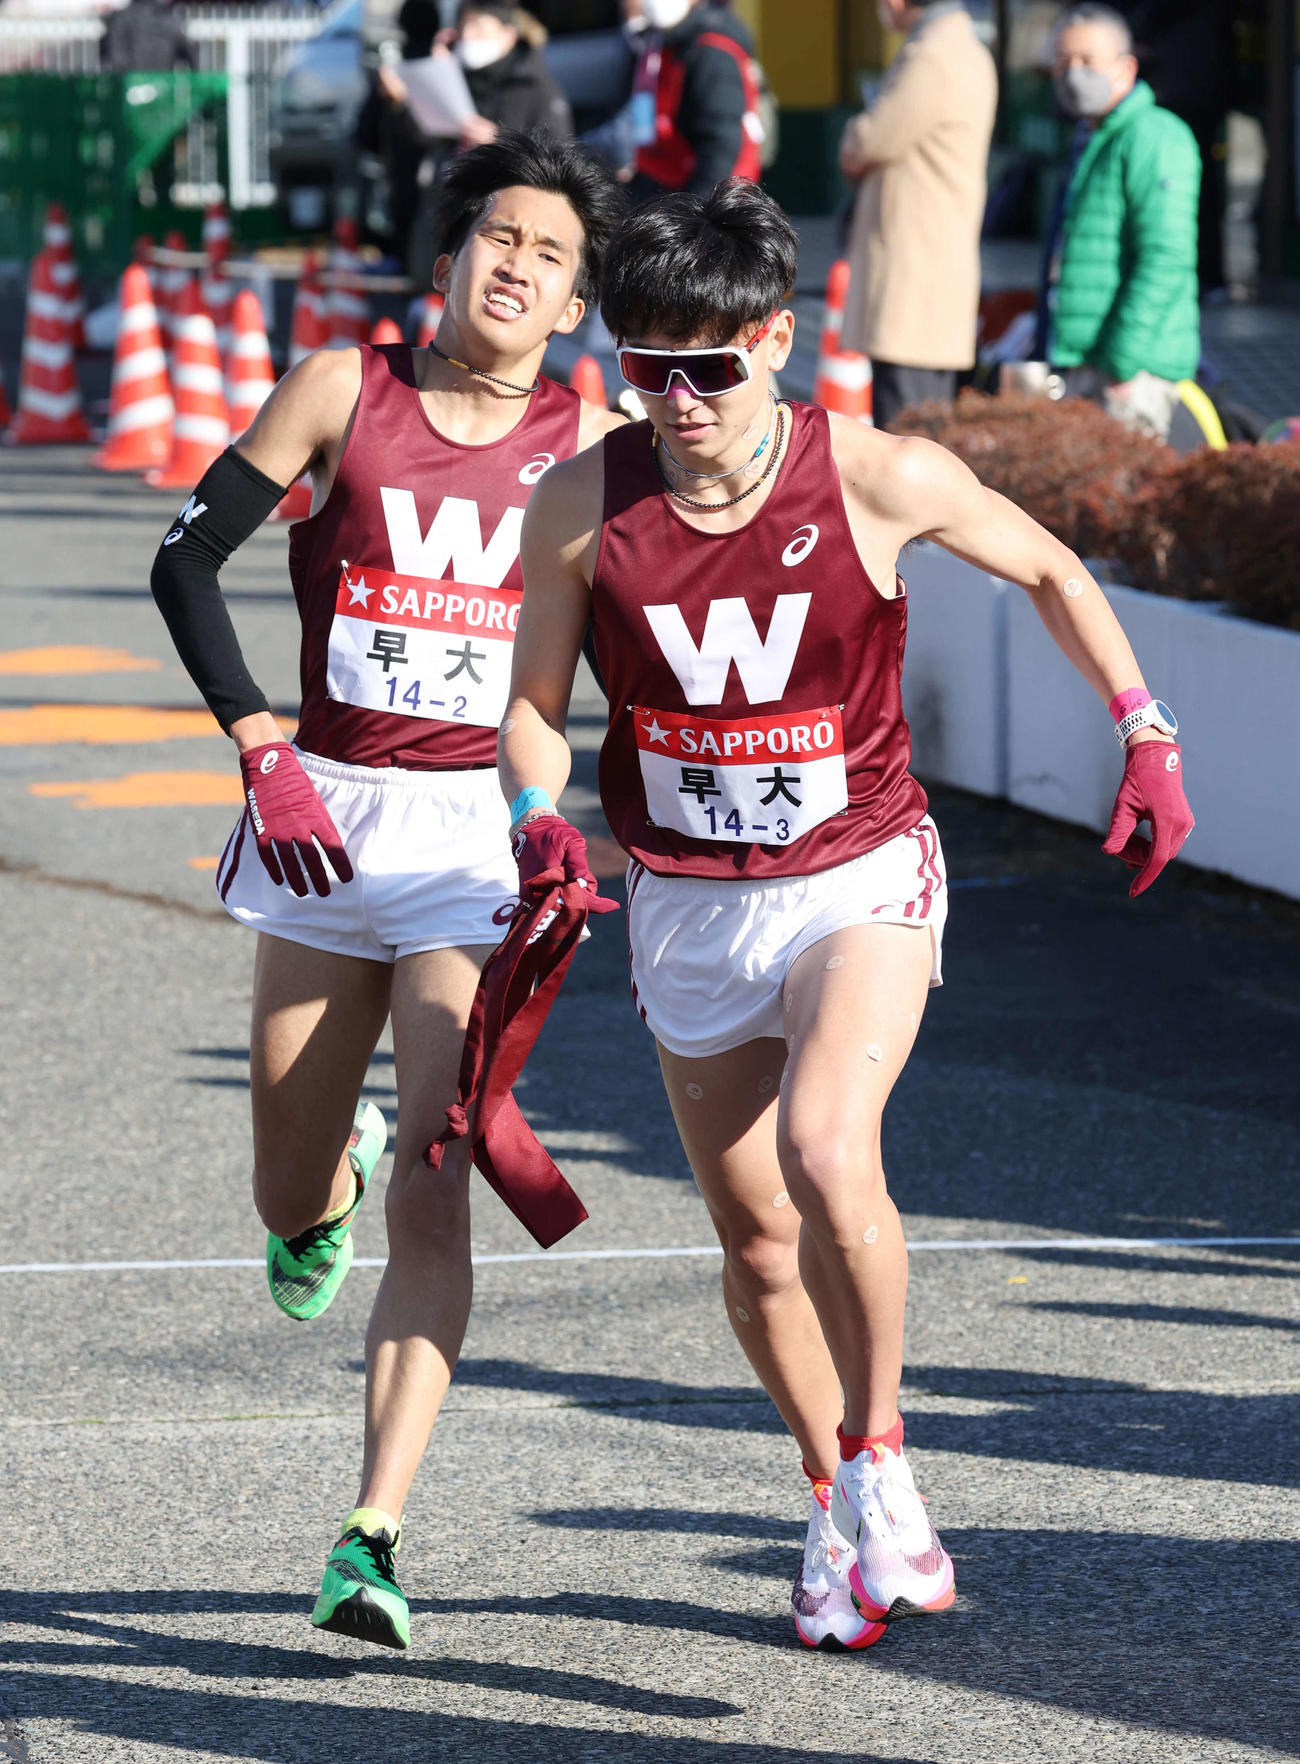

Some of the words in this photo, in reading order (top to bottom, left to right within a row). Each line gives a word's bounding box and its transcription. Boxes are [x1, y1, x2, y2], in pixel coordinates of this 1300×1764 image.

[380, 486, 526, 588] W
[642, 592, 813, 706] W
[385, 676, 468, 718] 14-2
[679, 720, 835, 757] SAPPORO
[247, 788, 266, 836] WASEDA
[703, 805, 791, 841] 14-3
